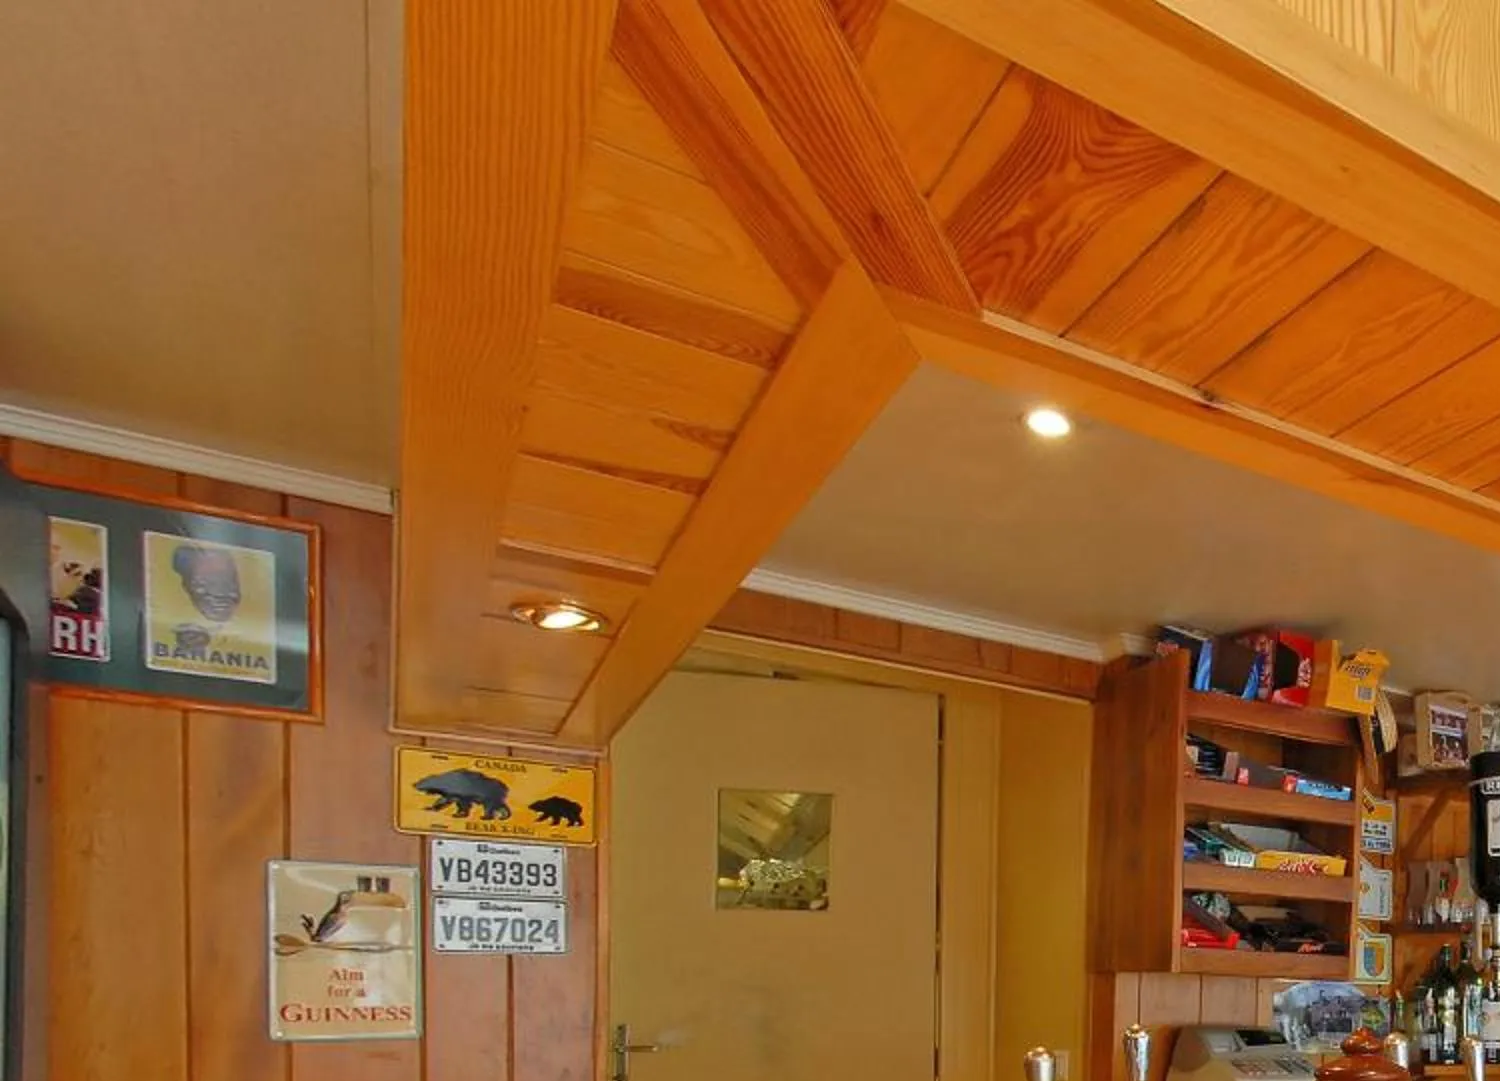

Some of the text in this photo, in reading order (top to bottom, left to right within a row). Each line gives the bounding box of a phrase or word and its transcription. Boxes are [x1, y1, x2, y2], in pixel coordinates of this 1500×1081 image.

[475, 759, 528, 773] CANADA
[439, 857, 557, 887] VB43393
[329, 969, 365, 981] Aim
[327, 985, 366, 998] for a
[280, 1003, 412, 1023] GUINNESS
